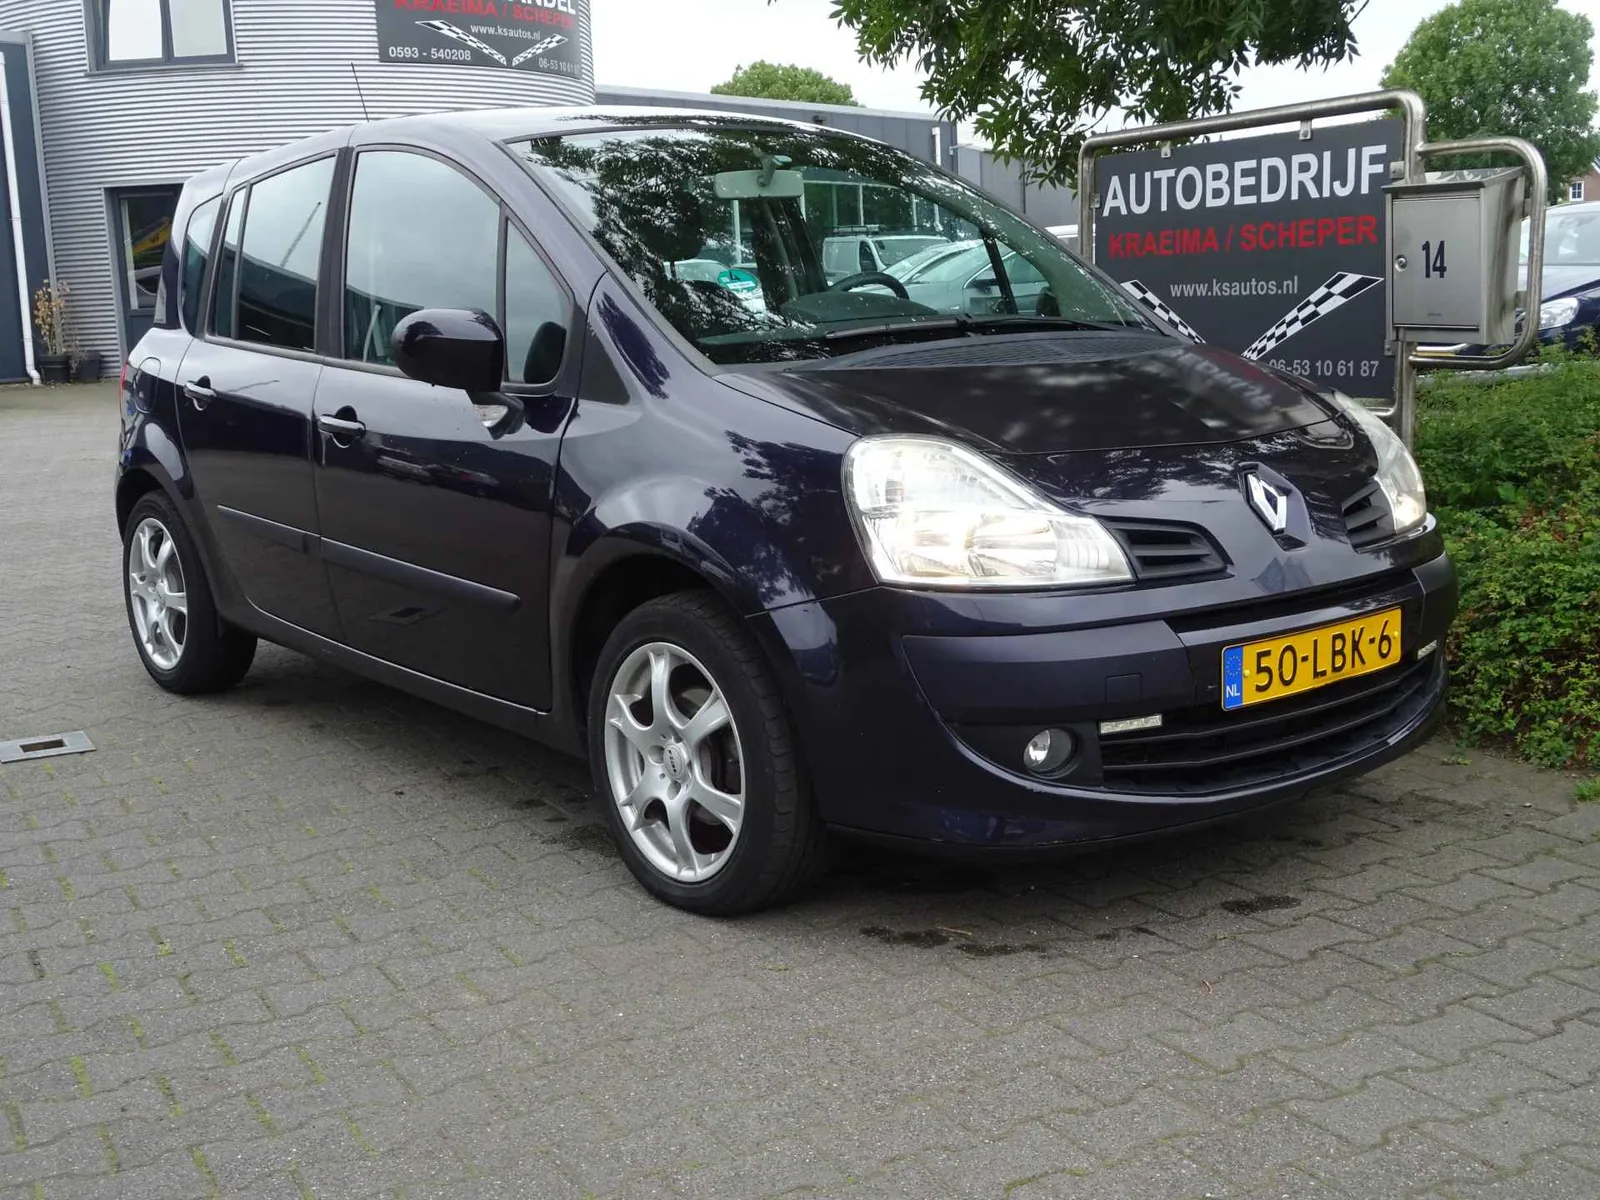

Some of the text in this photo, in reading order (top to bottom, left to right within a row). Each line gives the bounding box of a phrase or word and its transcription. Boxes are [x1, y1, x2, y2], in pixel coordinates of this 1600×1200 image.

[395, 0, 498, 16] KRAEIMA
[470, 24, 540, 40] www.ksautos.nl
[389, 46, 419, 58] 0593
[431, 48, 471, 61] 540208
[1102, 144, 1387, 217] AUTOBEDRIJF
[1108, 215, 1379, 260] KRAEIMA / SCHEPER
[1421, 240, 1447, 279] 14
[1170, 275, 1299, 298] www.ksautos.nl
[1315, 360, 1333, 376] 10
[1337, 360, 1355, 377] 61
[1360, 360, 1380, 377] 87
[1255, 619, 1392, 693] 50-LBK-6
[1226, 684, 1240, 698] NL
